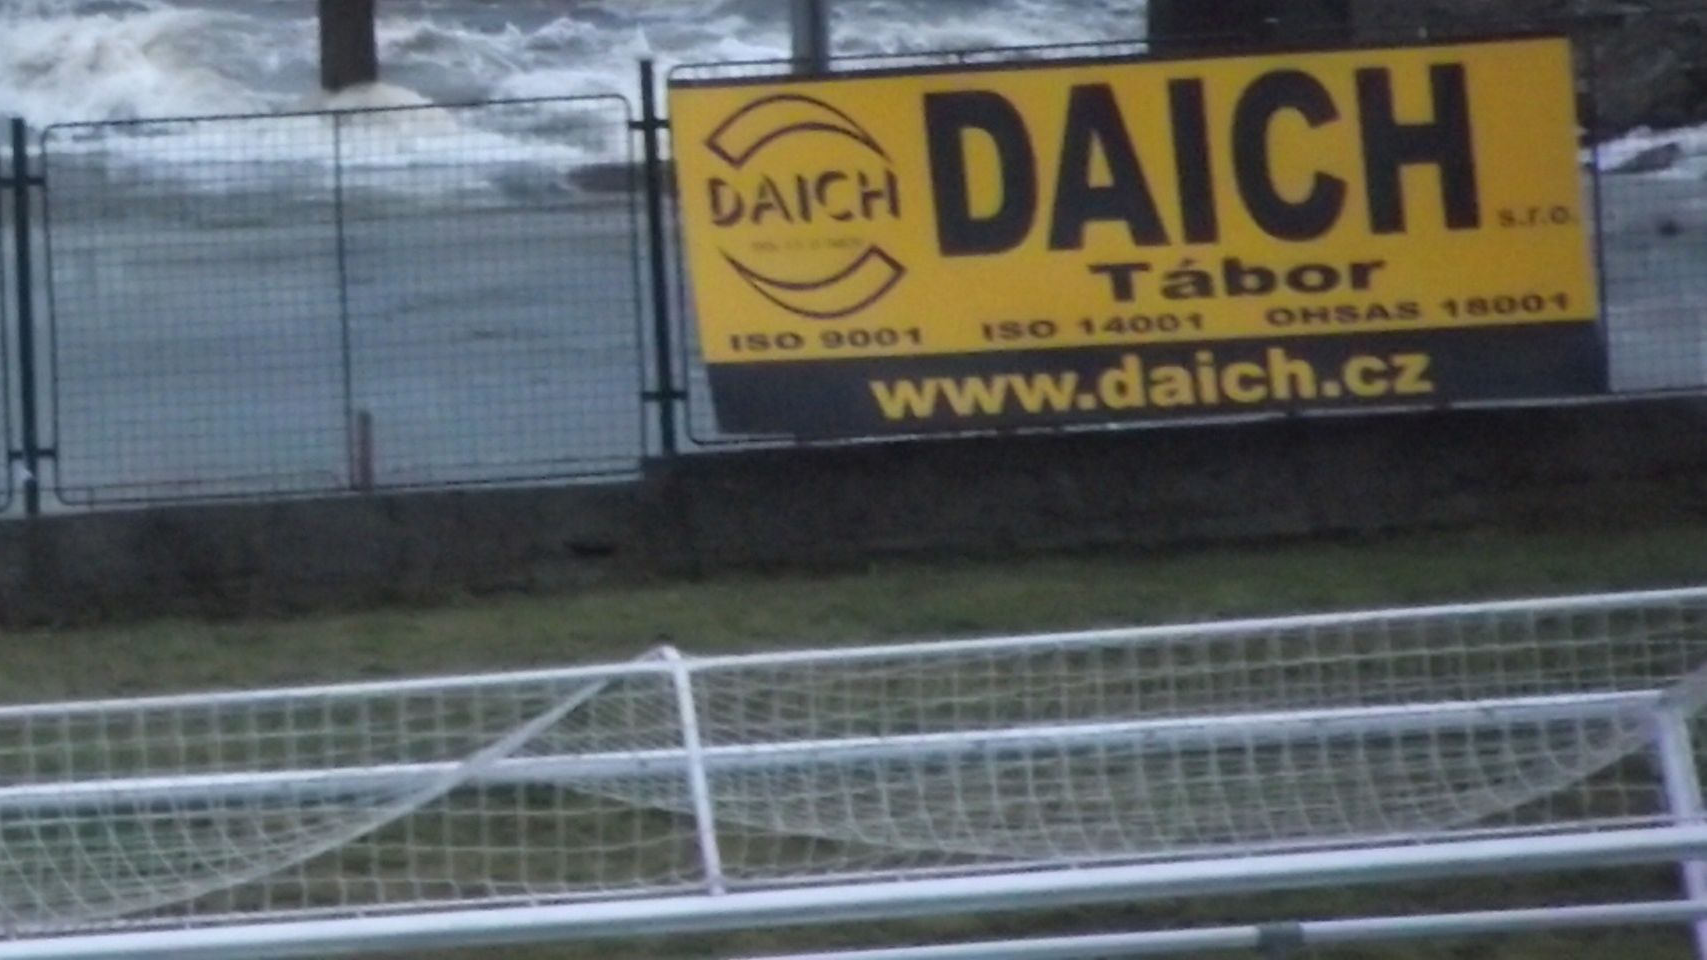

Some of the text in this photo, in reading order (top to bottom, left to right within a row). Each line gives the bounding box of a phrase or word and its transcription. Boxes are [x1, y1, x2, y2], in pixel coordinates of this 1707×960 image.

[923, 62, 1482, 258] DAICH
[706, 167, 901, 228] DAICH
[1498, 204, 1579, 228] s.r.o.
[1087, 256, 1387, 303] Tábor
[981, 312, 1205, 341] ISO 14001
[1264, 292, 1571, 327] OHSAS 18001
[729, 326, 924, 353] ISO 9001
[868, 346, 1435, 420] www.daich.cz
